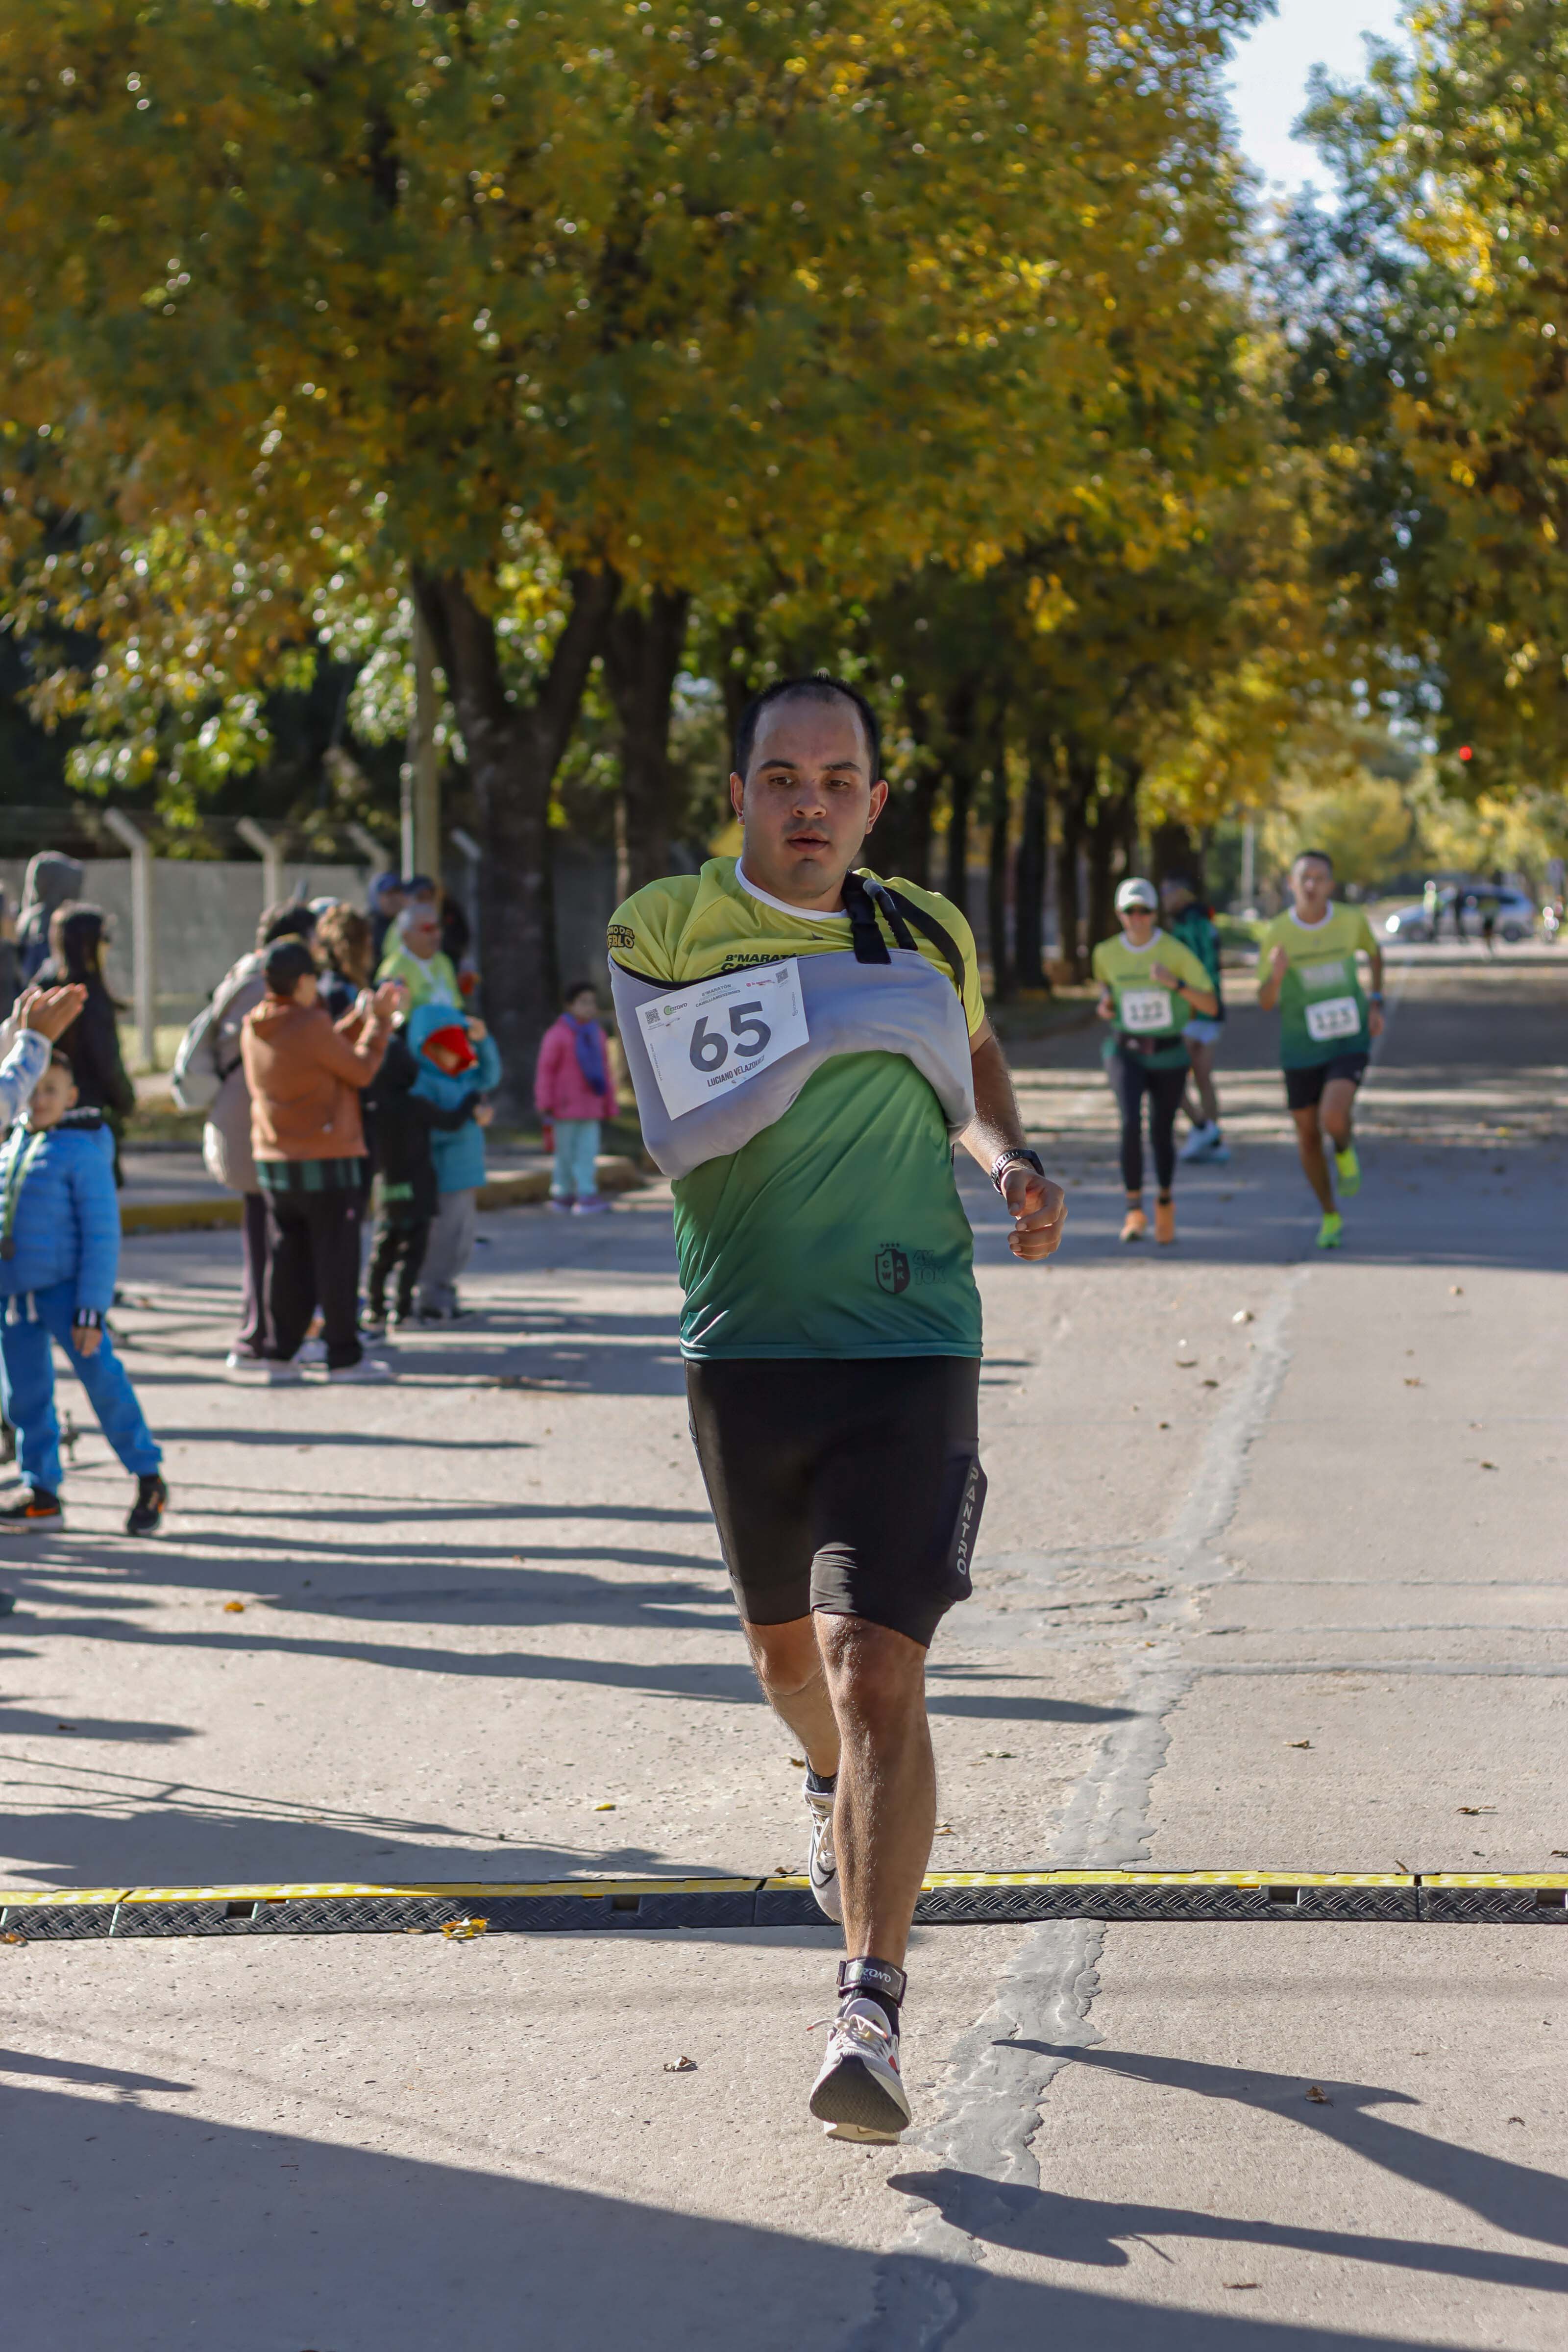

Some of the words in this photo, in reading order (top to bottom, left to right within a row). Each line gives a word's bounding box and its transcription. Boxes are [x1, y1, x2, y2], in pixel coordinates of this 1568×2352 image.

[725, 953, 804, 962] 8°MARAT
[689, 1001, 771, 1072] 65
[707, 1070, 734, 1087] LUCIANO
[734, 1054, 765, 1076] VELAZQUEZ
[956, 1467, 980, 1576] PANTRO
[859, 1967, 891, 1983] RONO
